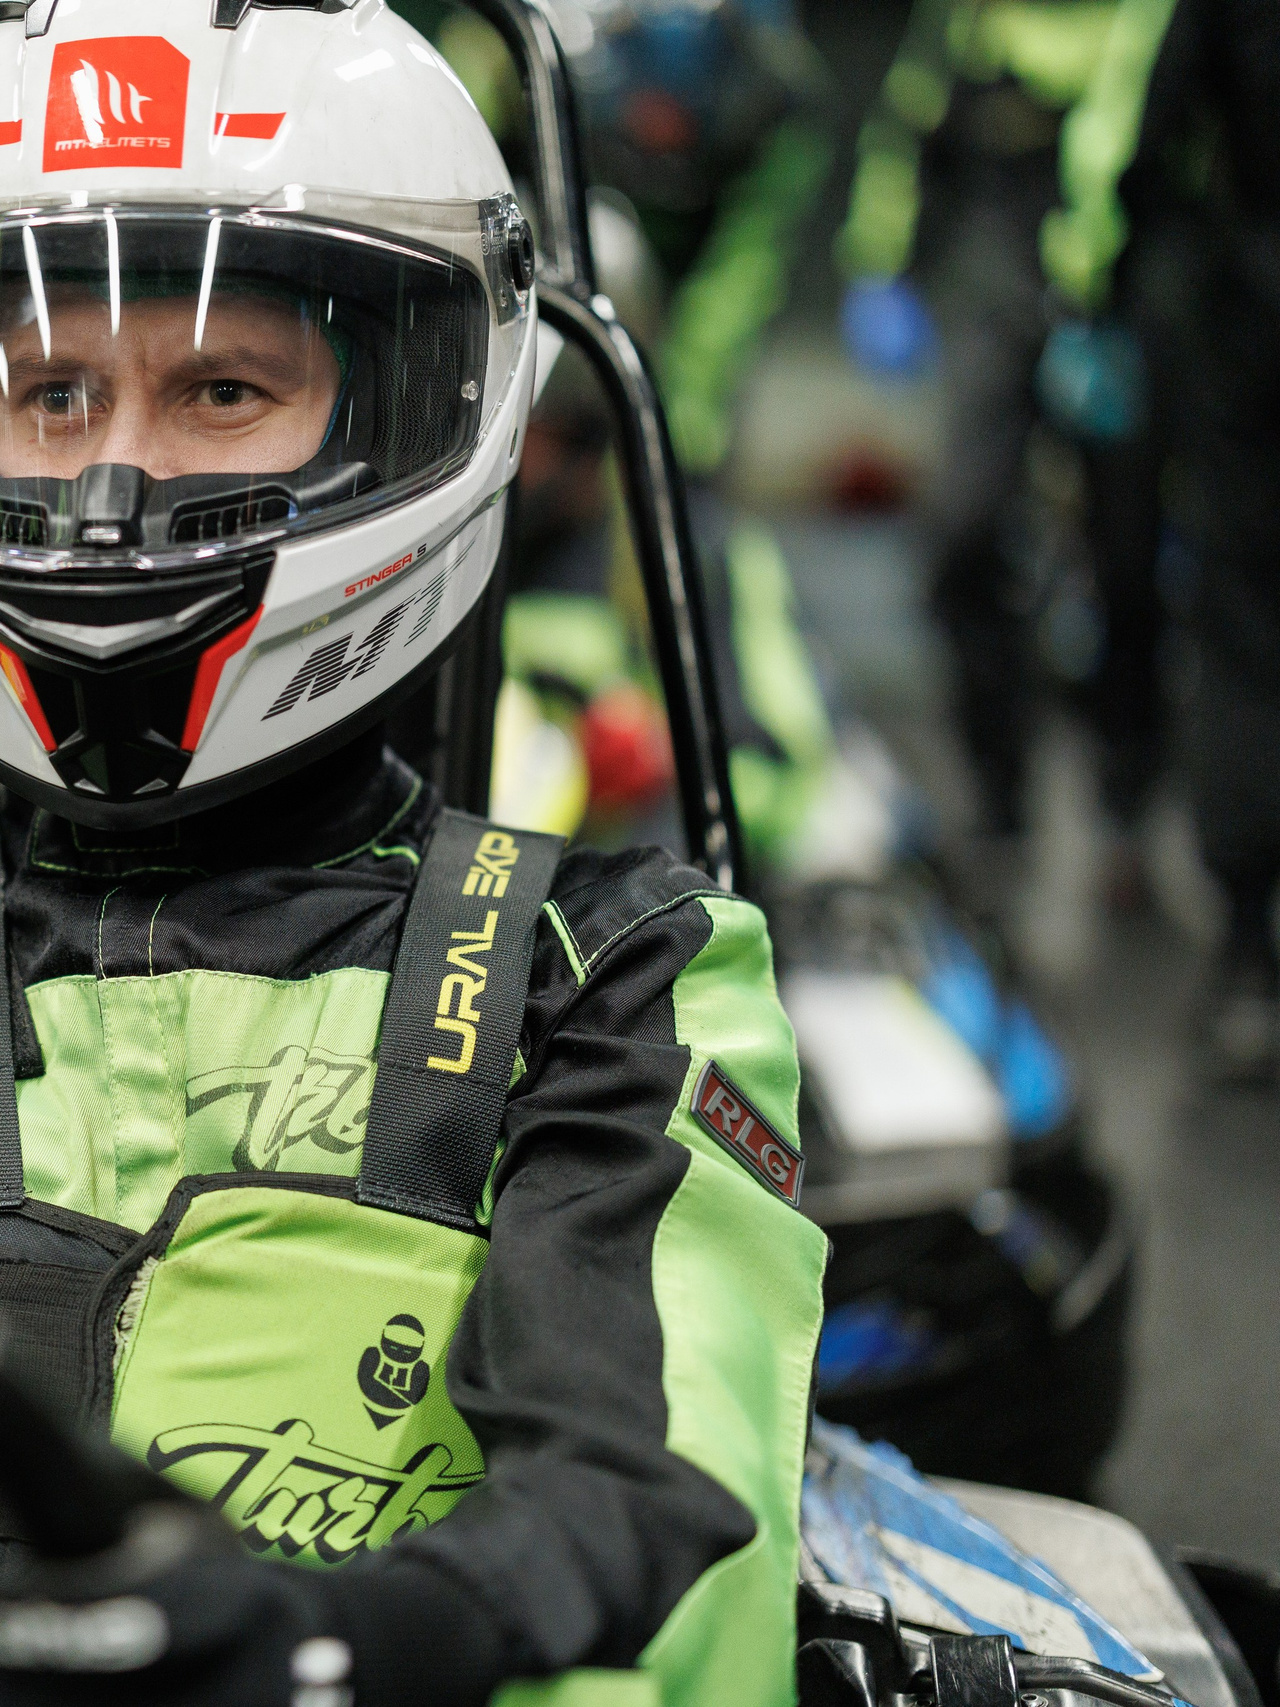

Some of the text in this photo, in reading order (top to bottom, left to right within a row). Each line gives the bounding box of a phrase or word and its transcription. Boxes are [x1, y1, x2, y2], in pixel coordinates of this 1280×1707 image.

[344, 552, 413, 598] STINGER
[426, 910, 500, 1074] URAL
[703, 1086, 792, 1185] RLG
